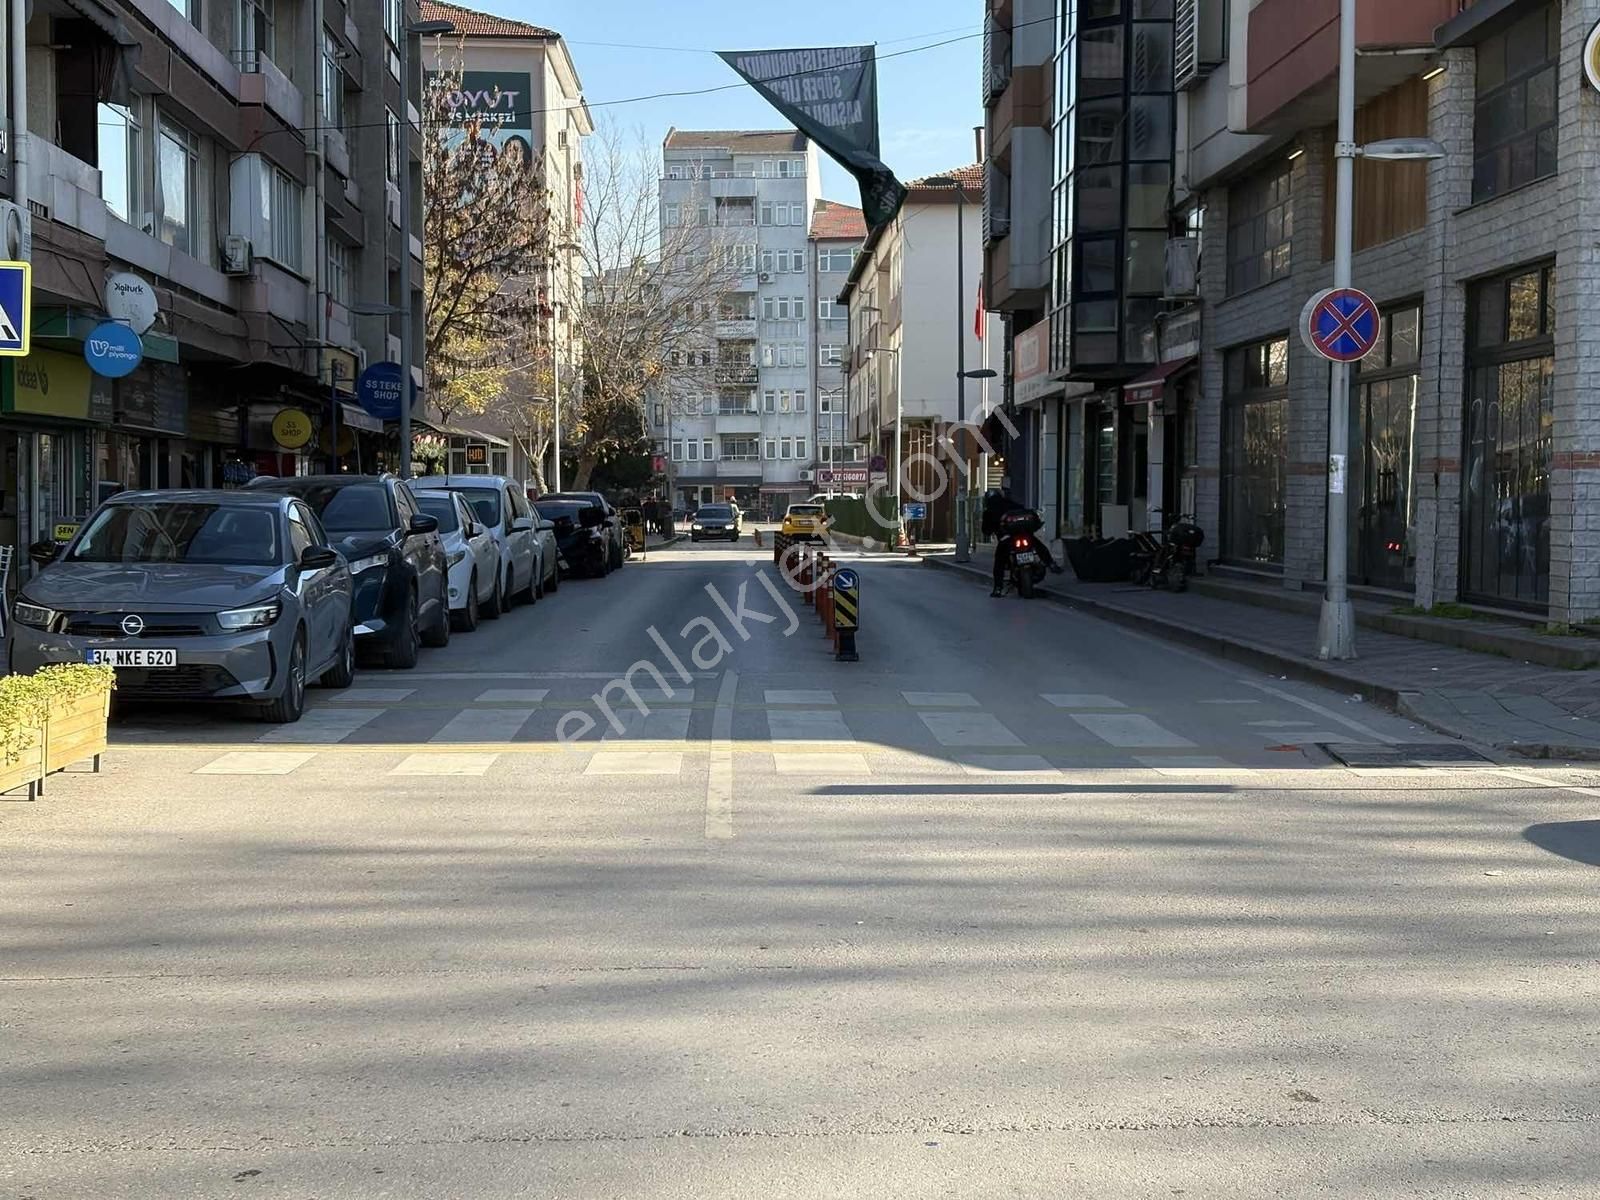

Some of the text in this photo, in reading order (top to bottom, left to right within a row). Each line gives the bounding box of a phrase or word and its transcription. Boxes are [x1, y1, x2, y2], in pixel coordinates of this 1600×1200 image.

[108, 351, 138, 361] piyango
[365, 380, 378, 389] SS
[374, 390, 399, 400] SHOP
[280, 429, 302, 437] SHOP
[94, 651, 173, 665] 34 NKE 620
